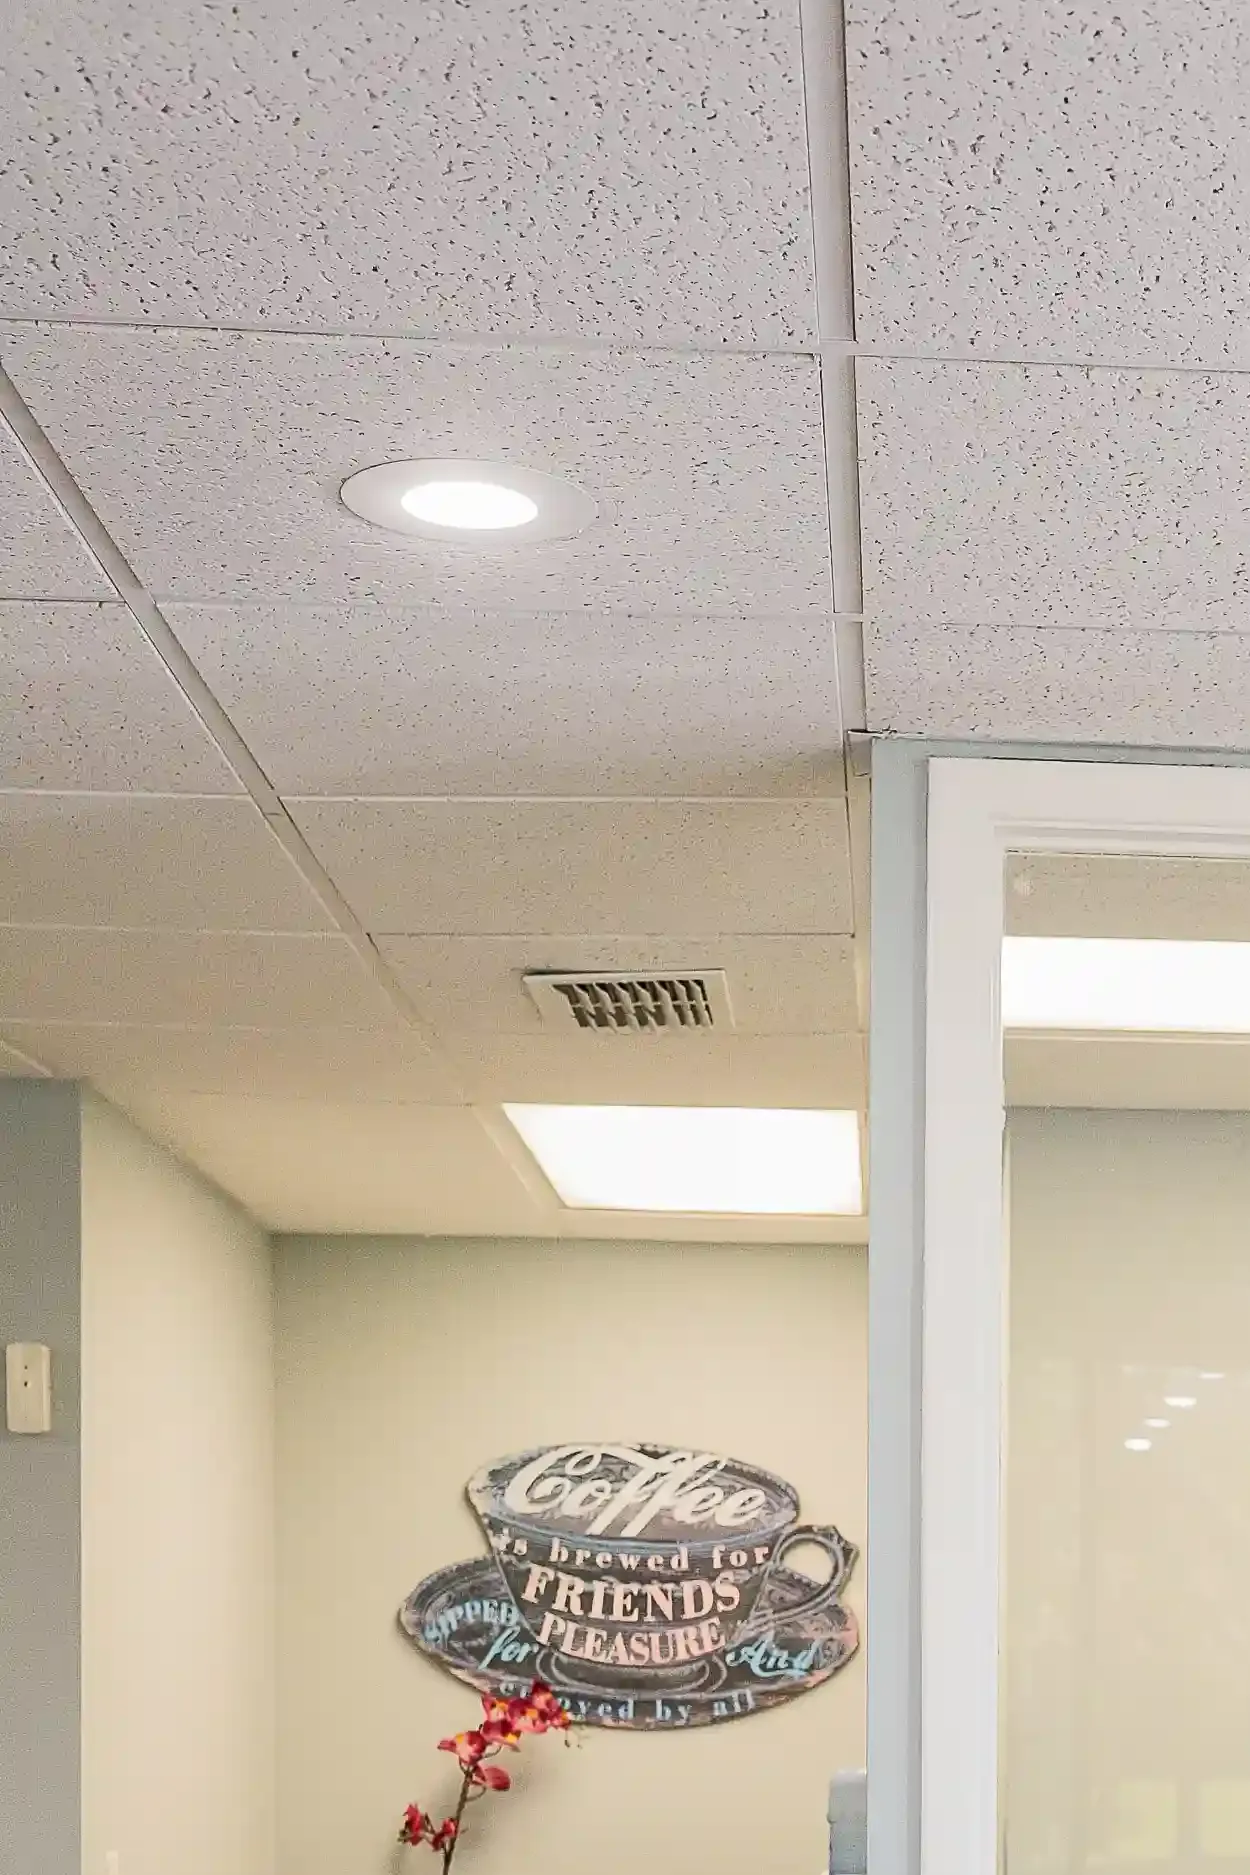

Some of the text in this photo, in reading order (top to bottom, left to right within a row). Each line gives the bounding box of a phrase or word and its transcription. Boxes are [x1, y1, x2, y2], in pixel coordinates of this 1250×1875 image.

[504, 1444, 767, 1538] Coffee
[549, 1536, 690, 1572] brewed
[711, 1543, 769, 1570] for
[520, 1563, 741, 1623] FRIENDS
[422, 1599, 520, 1644] SIPPED
[535, 1612, 726, 1667] PLEASURE
[477, 1625, 541, 1670] for
[725, 1630, 824, 1678] And
[655, 1699, 693, 1726] by
